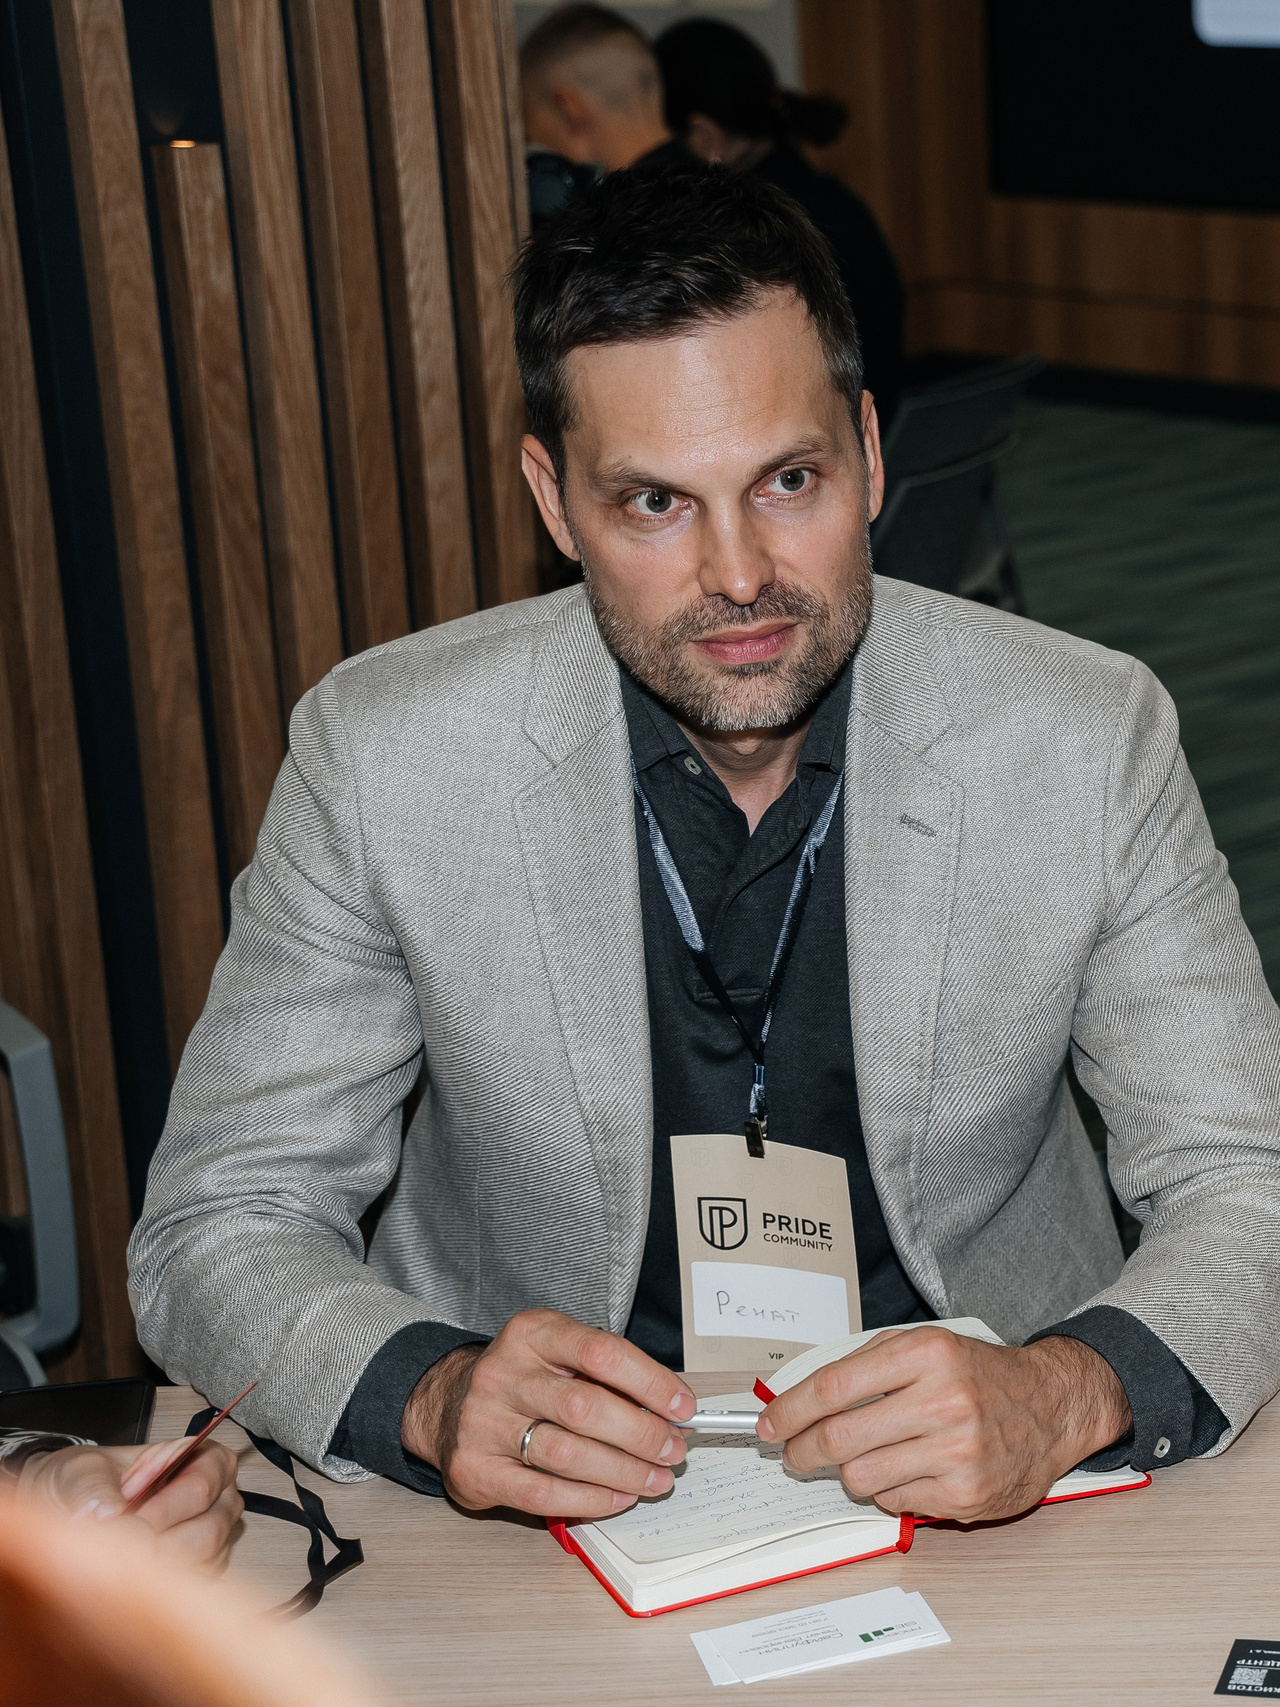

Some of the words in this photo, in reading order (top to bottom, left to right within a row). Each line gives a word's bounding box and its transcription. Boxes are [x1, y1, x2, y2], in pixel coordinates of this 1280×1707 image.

[762, 1212, 833, 1240] PRIDE
[763, 1233, 833, 1252] COMMUNITY
[768, 1352, 785, 1361] VIP
[1237, 1659, 1280, 1667] ЦЕНТР
